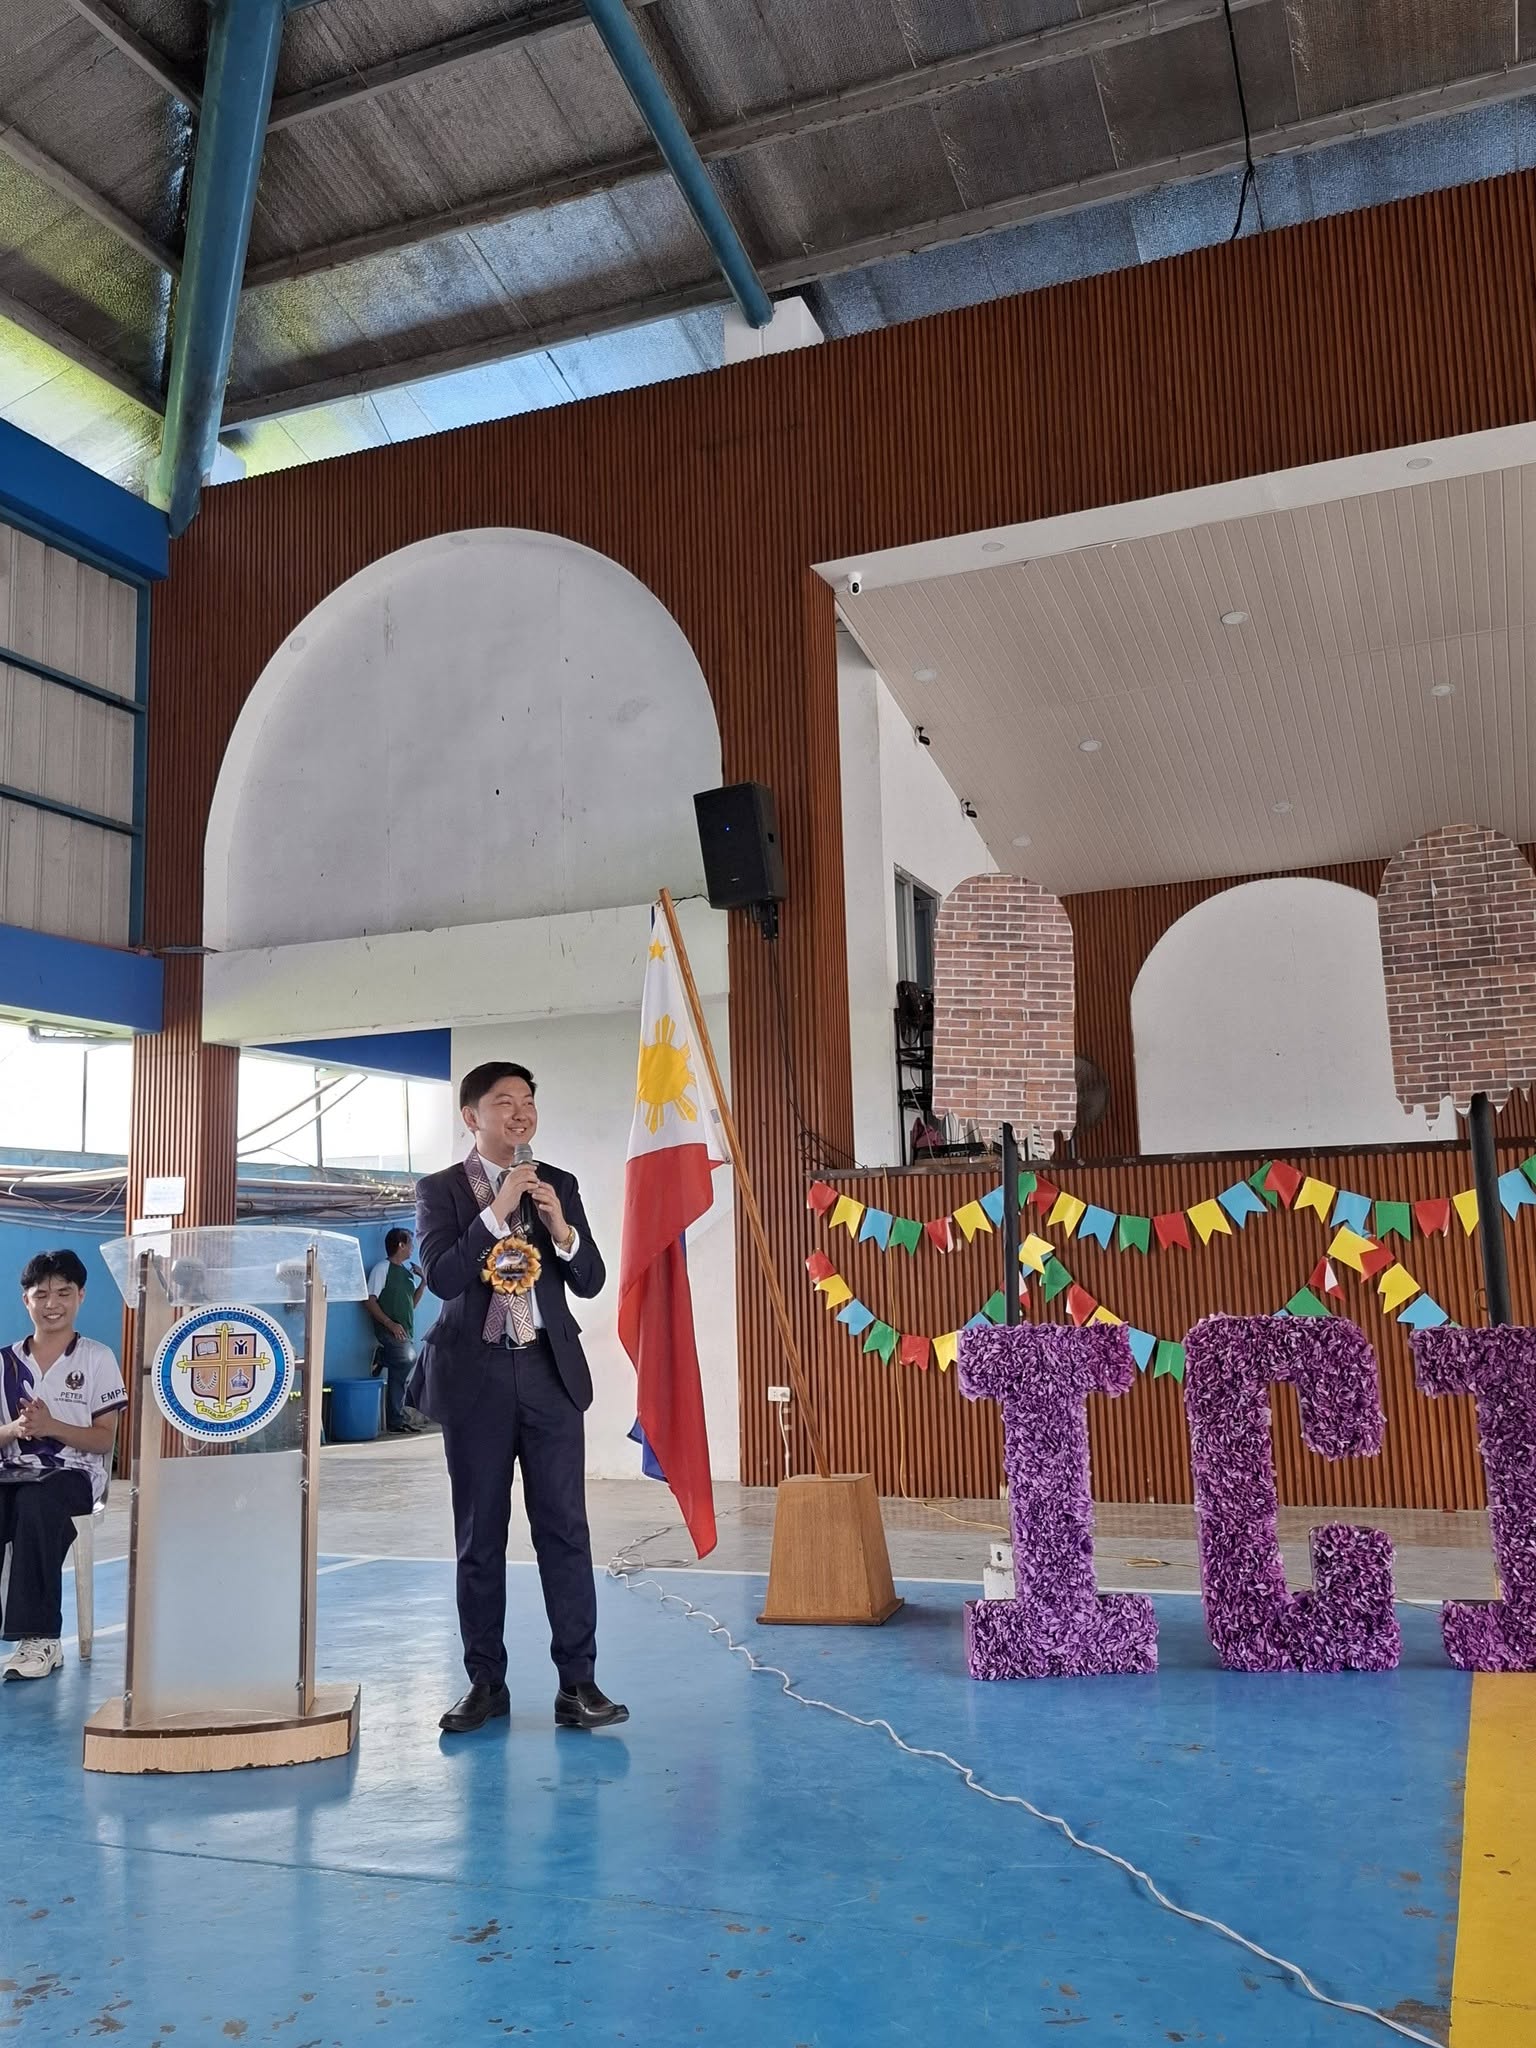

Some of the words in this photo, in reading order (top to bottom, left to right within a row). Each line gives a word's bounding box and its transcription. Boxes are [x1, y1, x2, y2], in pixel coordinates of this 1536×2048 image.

[171, 1311, 225, 1352] IMMACULATE
[226, 1311, 278, 1347] CONCEPTION
[60, 1391, 83, 1400] PETER
[164, 1384, 190, 1421] COLLEGE
[191, 1416, 202, 1428] OF
[203, 1421, 226, 1432] ARTS
[229, 1417, 247, 1430] AND
[248, 1369, 284, 1422] TECHNOLOGY
